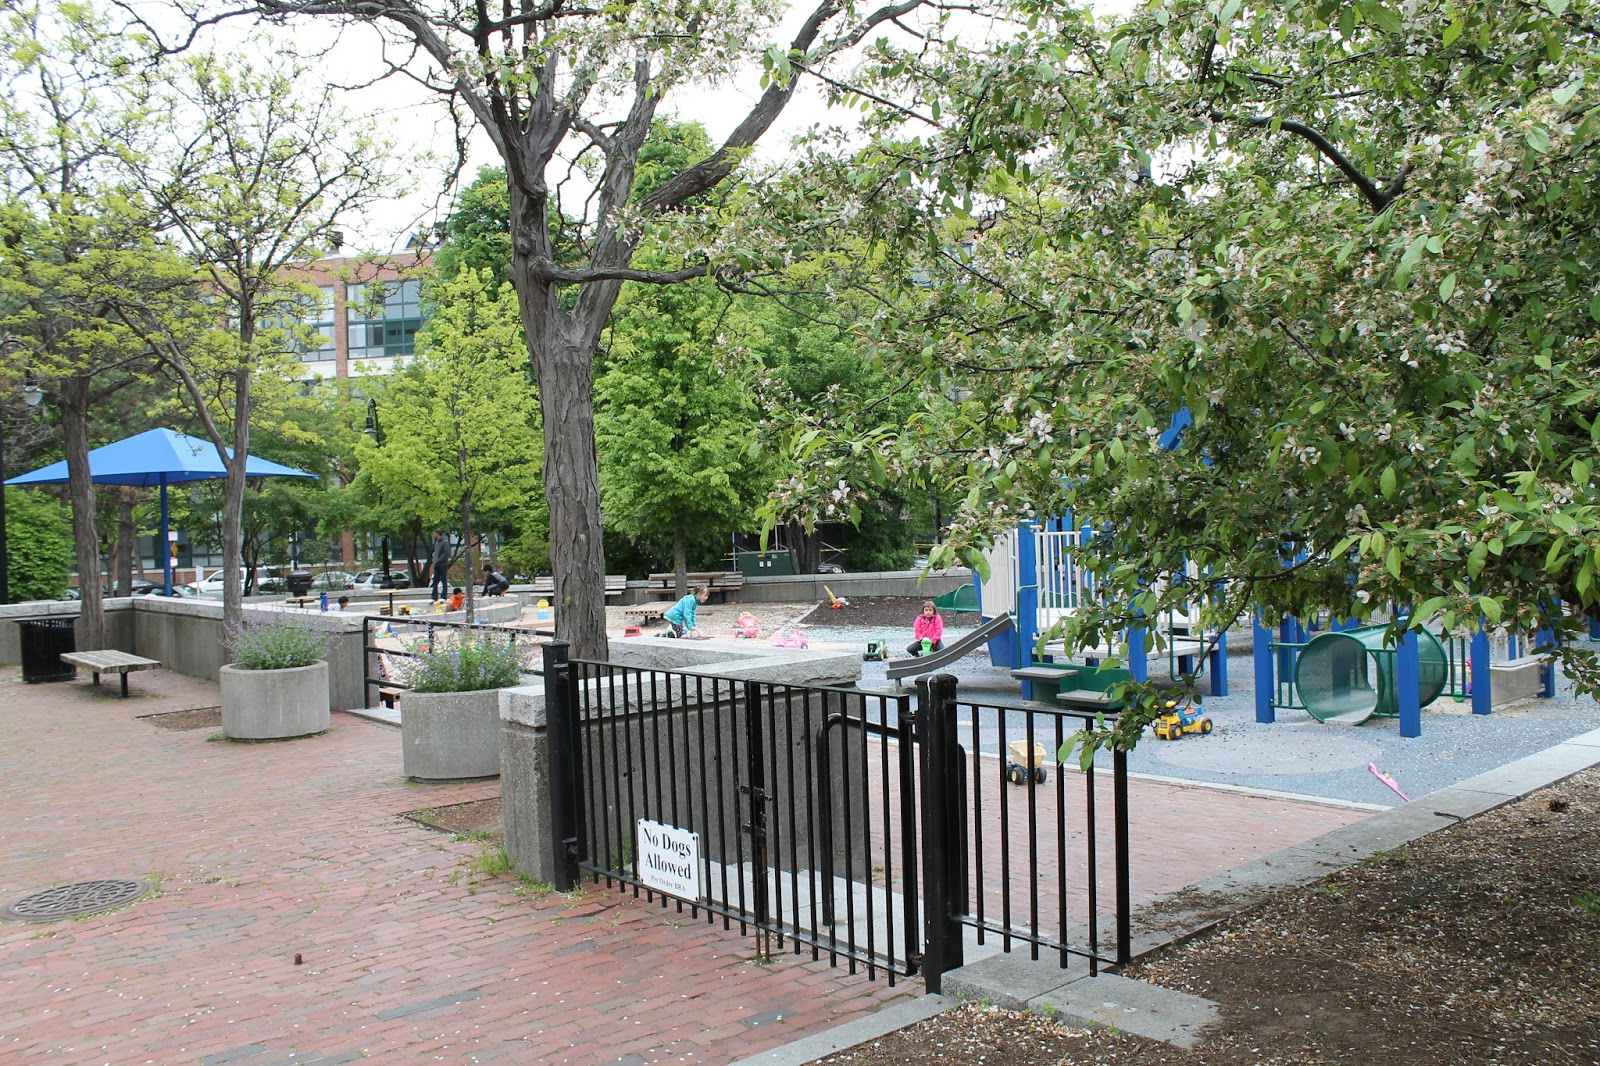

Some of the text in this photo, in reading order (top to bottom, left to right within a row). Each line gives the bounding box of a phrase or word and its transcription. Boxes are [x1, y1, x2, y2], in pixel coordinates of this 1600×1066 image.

[644, 828, 691, 859] No Dogs
[645, 852, 691, 880] Allowed
[659, 878, 673, 888] Order
